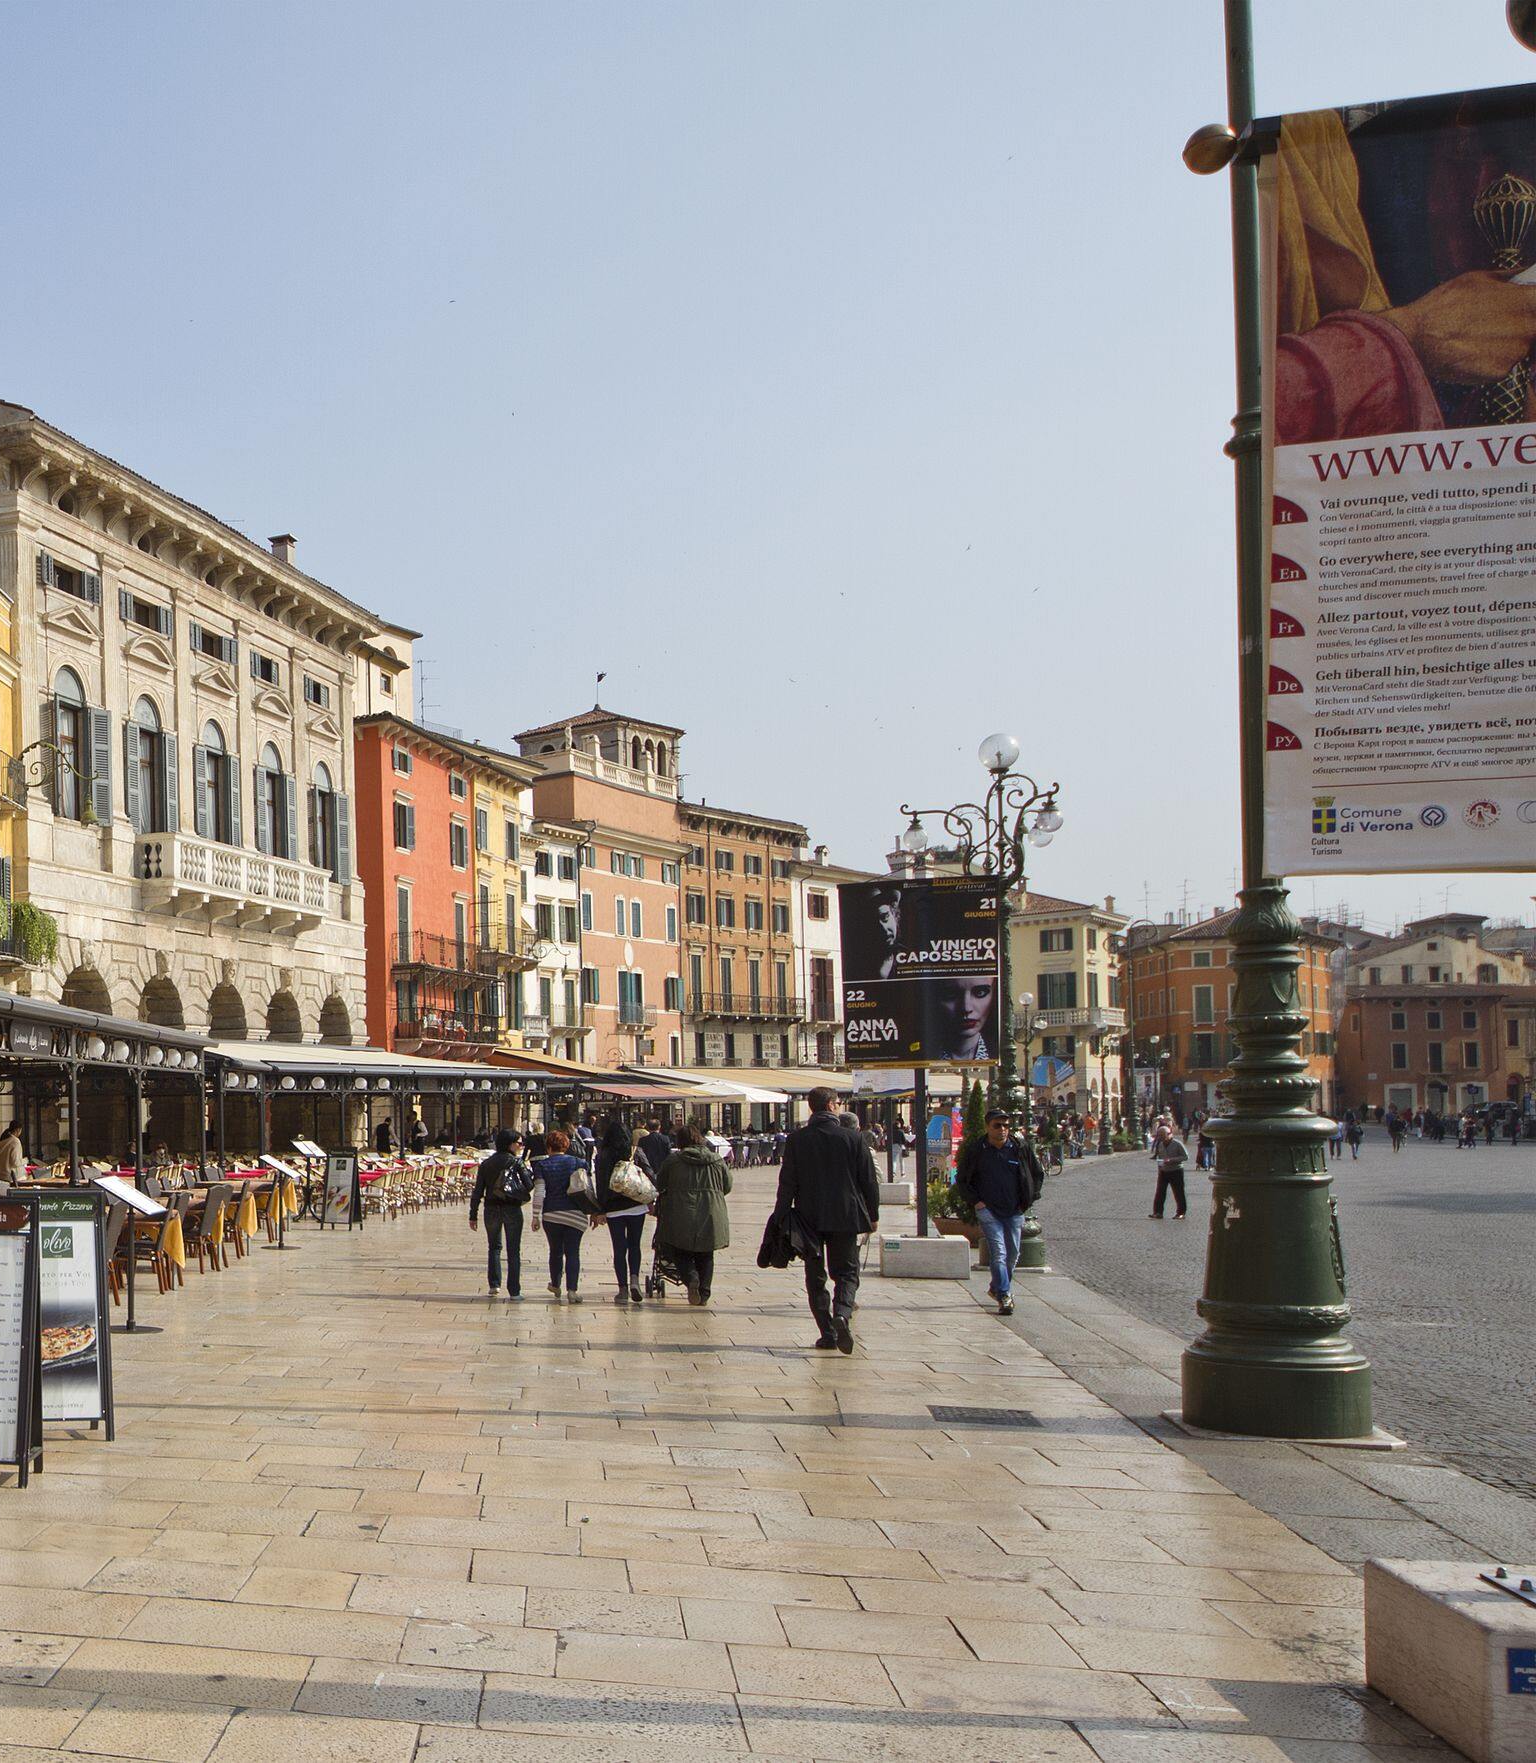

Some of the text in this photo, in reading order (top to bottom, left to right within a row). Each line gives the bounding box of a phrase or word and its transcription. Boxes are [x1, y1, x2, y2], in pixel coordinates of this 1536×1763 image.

[1320, 483, 1529, 509] Vai ovunque, vedi tutto, spendi
[1280, 511, 1292, 522] It
[1338, 509, 1394, 521] VeronaCard,
[1406, 506, 1426, 514] città
[1456, 499, 1518, 511] disposizione:
[1319, 525, 1347, 534] chiese
[1361, 520, 1417, 532] monumenti,
[1419, 517, 1451, 528] viaggia
[1452, 512, 1516, 525] gratuitamente
[1517, 510, 1532, 518] sui
[1319, 532, 1430, 548] scopri tanto altro ancora.
[1319, 542, 1513, 566] Go everywhere, see everything
[1279, 568, 1299, 580] En
[1340, 566, 1396, 578] VeronaCard,
[1415, 564, 1433, 573] city
[1454, 562, 1475, 570] your
[1476, 557, 1517, 568] disposal:
[1318, 568, 1530, 590] churches and monuments, travel free of charge
[1318, 595, 1343, 603] buses
[1363, 591, 1402, 600] discover
[1404, 589, 1430, 597] much
[1432, 587, 1459, 595] much
[1317, 611, 1350, 622] Allez
[1353, 607, 1408, 623] partout,
[1411, 607, 1449, 619] voyez
[1453, 602, 1486, 616] tout,
[1278, 622, 1294, 634] Fr
[1316, 658, 1525, 680] Geh überall hin, besichtige alles
[1276, 681, 1298, 692] De
[1340, 807, 1402, 819] Comune
[1340, 820, 1413, 833] di Verona
[1311, 837, 1340, 846] Cultura
[1311, 847, 1343, 856] Turismo
[980, 898, 996, 909] 21
[930, 938, 996, 950] VINICIO
[896, 950, 996, 964] CAPOSSELA
[847, 990, 866, 1001] 22
[847, 1018, 897, 1032] ANNA
[847, 1030, 898, 1042] CALVI
[61, 1200, 93, 1211] Pizzeria
[43, 1228, 72, 1254] olivo
